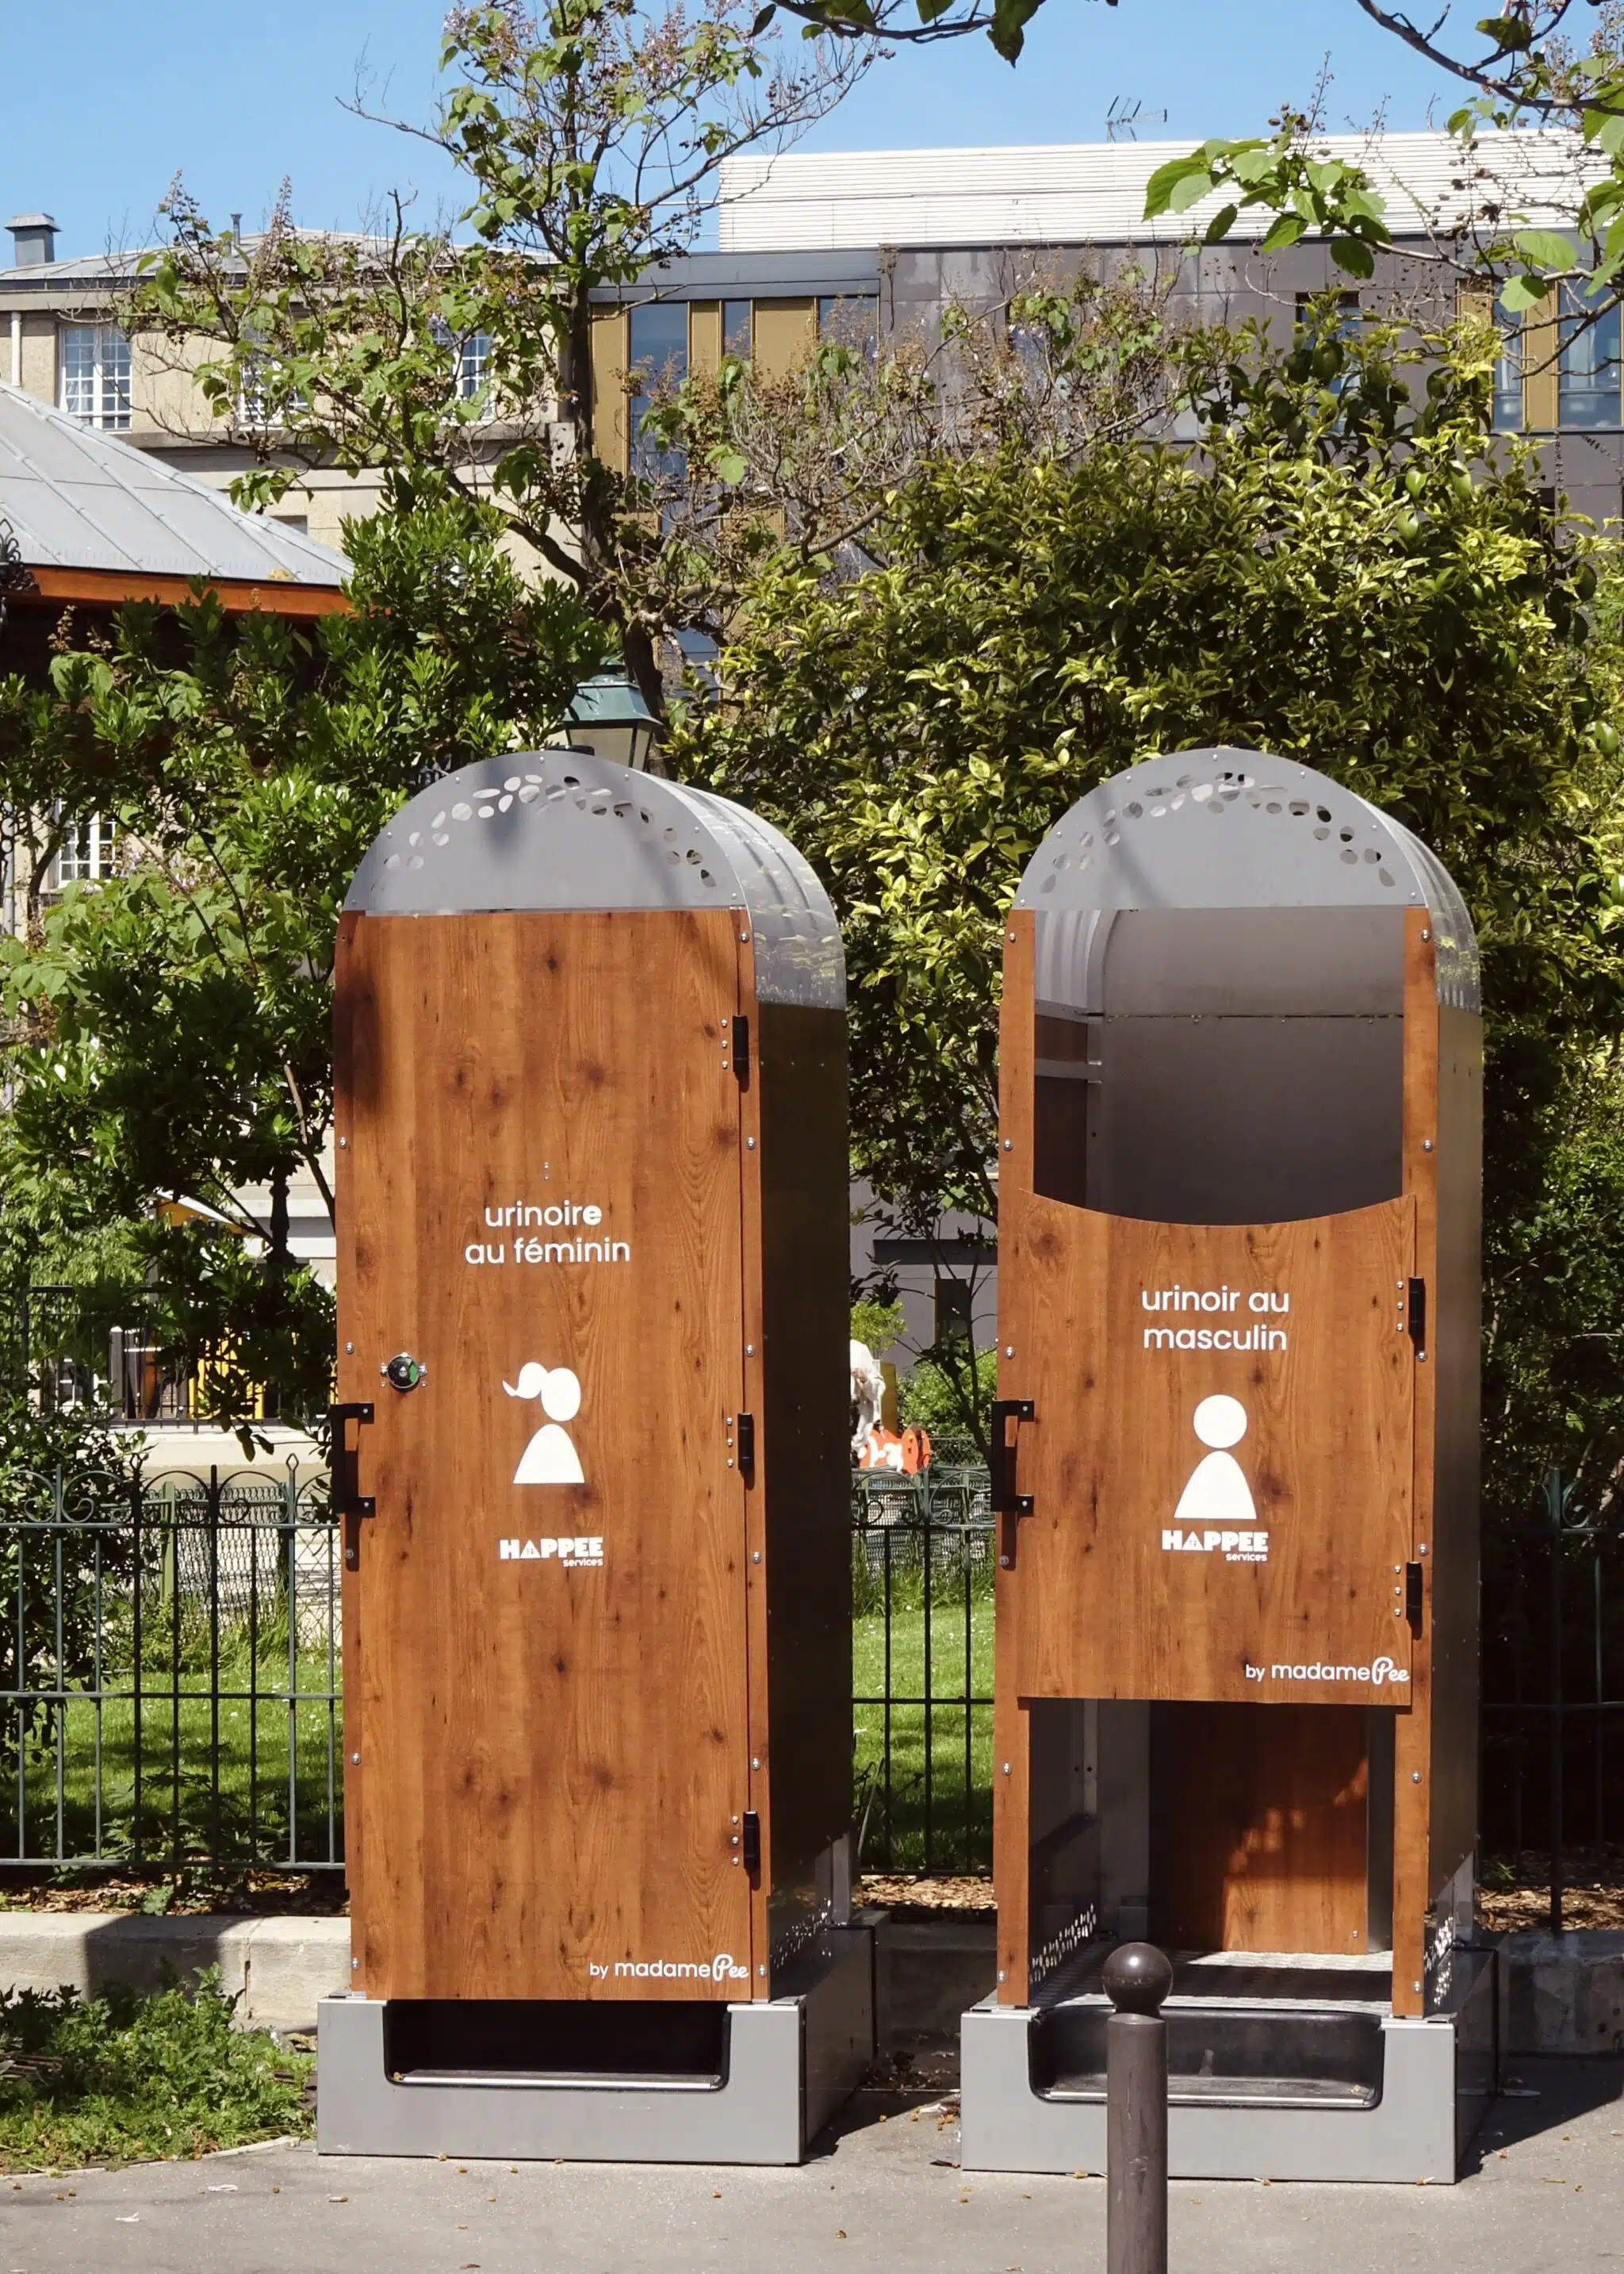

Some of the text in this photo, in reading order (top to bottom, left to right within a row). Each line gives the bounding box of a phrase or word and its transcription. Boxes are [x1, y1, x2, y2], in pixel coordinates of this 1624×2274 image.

[485, 1199, 603, 1227] urinoire
[465, 1237, 630, 1264] au féminin
[1142, 1284, 1289, 1313] urinoir au
[1143, 1323, 1287, 1351] masculin
[499, 1536, 604, 1560] HAPPEE
[1161, 1529, 1269, 1553] HAPPEE
[562, 1557, 603, 1567] services
[1225, 1551, 1268, 1562] services
[1245, 1664, 1266, 1682] by
[589, 1962, 609, 1981] by
